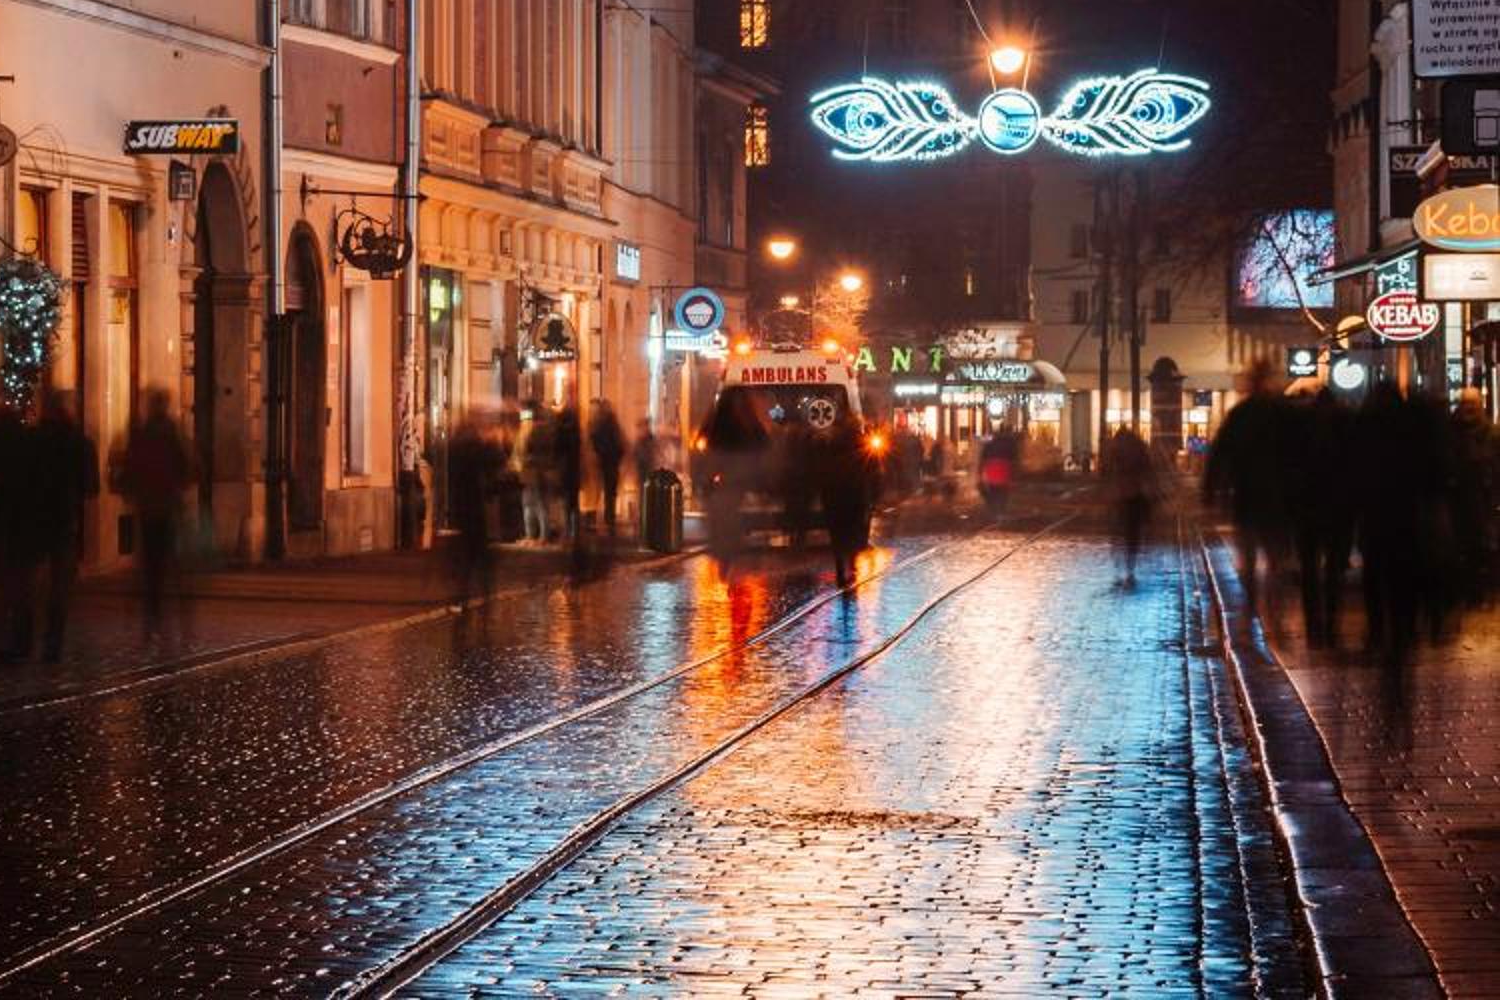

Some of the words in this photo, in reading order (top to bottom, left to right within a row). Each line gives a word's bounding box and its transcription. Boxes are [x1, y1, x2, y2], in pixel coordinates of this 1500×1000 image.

[129, 123, 235, 149] SUBWAY
[1372, 302, 1438, 326] KEBAB
[741, 366, 828, 383] AMBULANS
